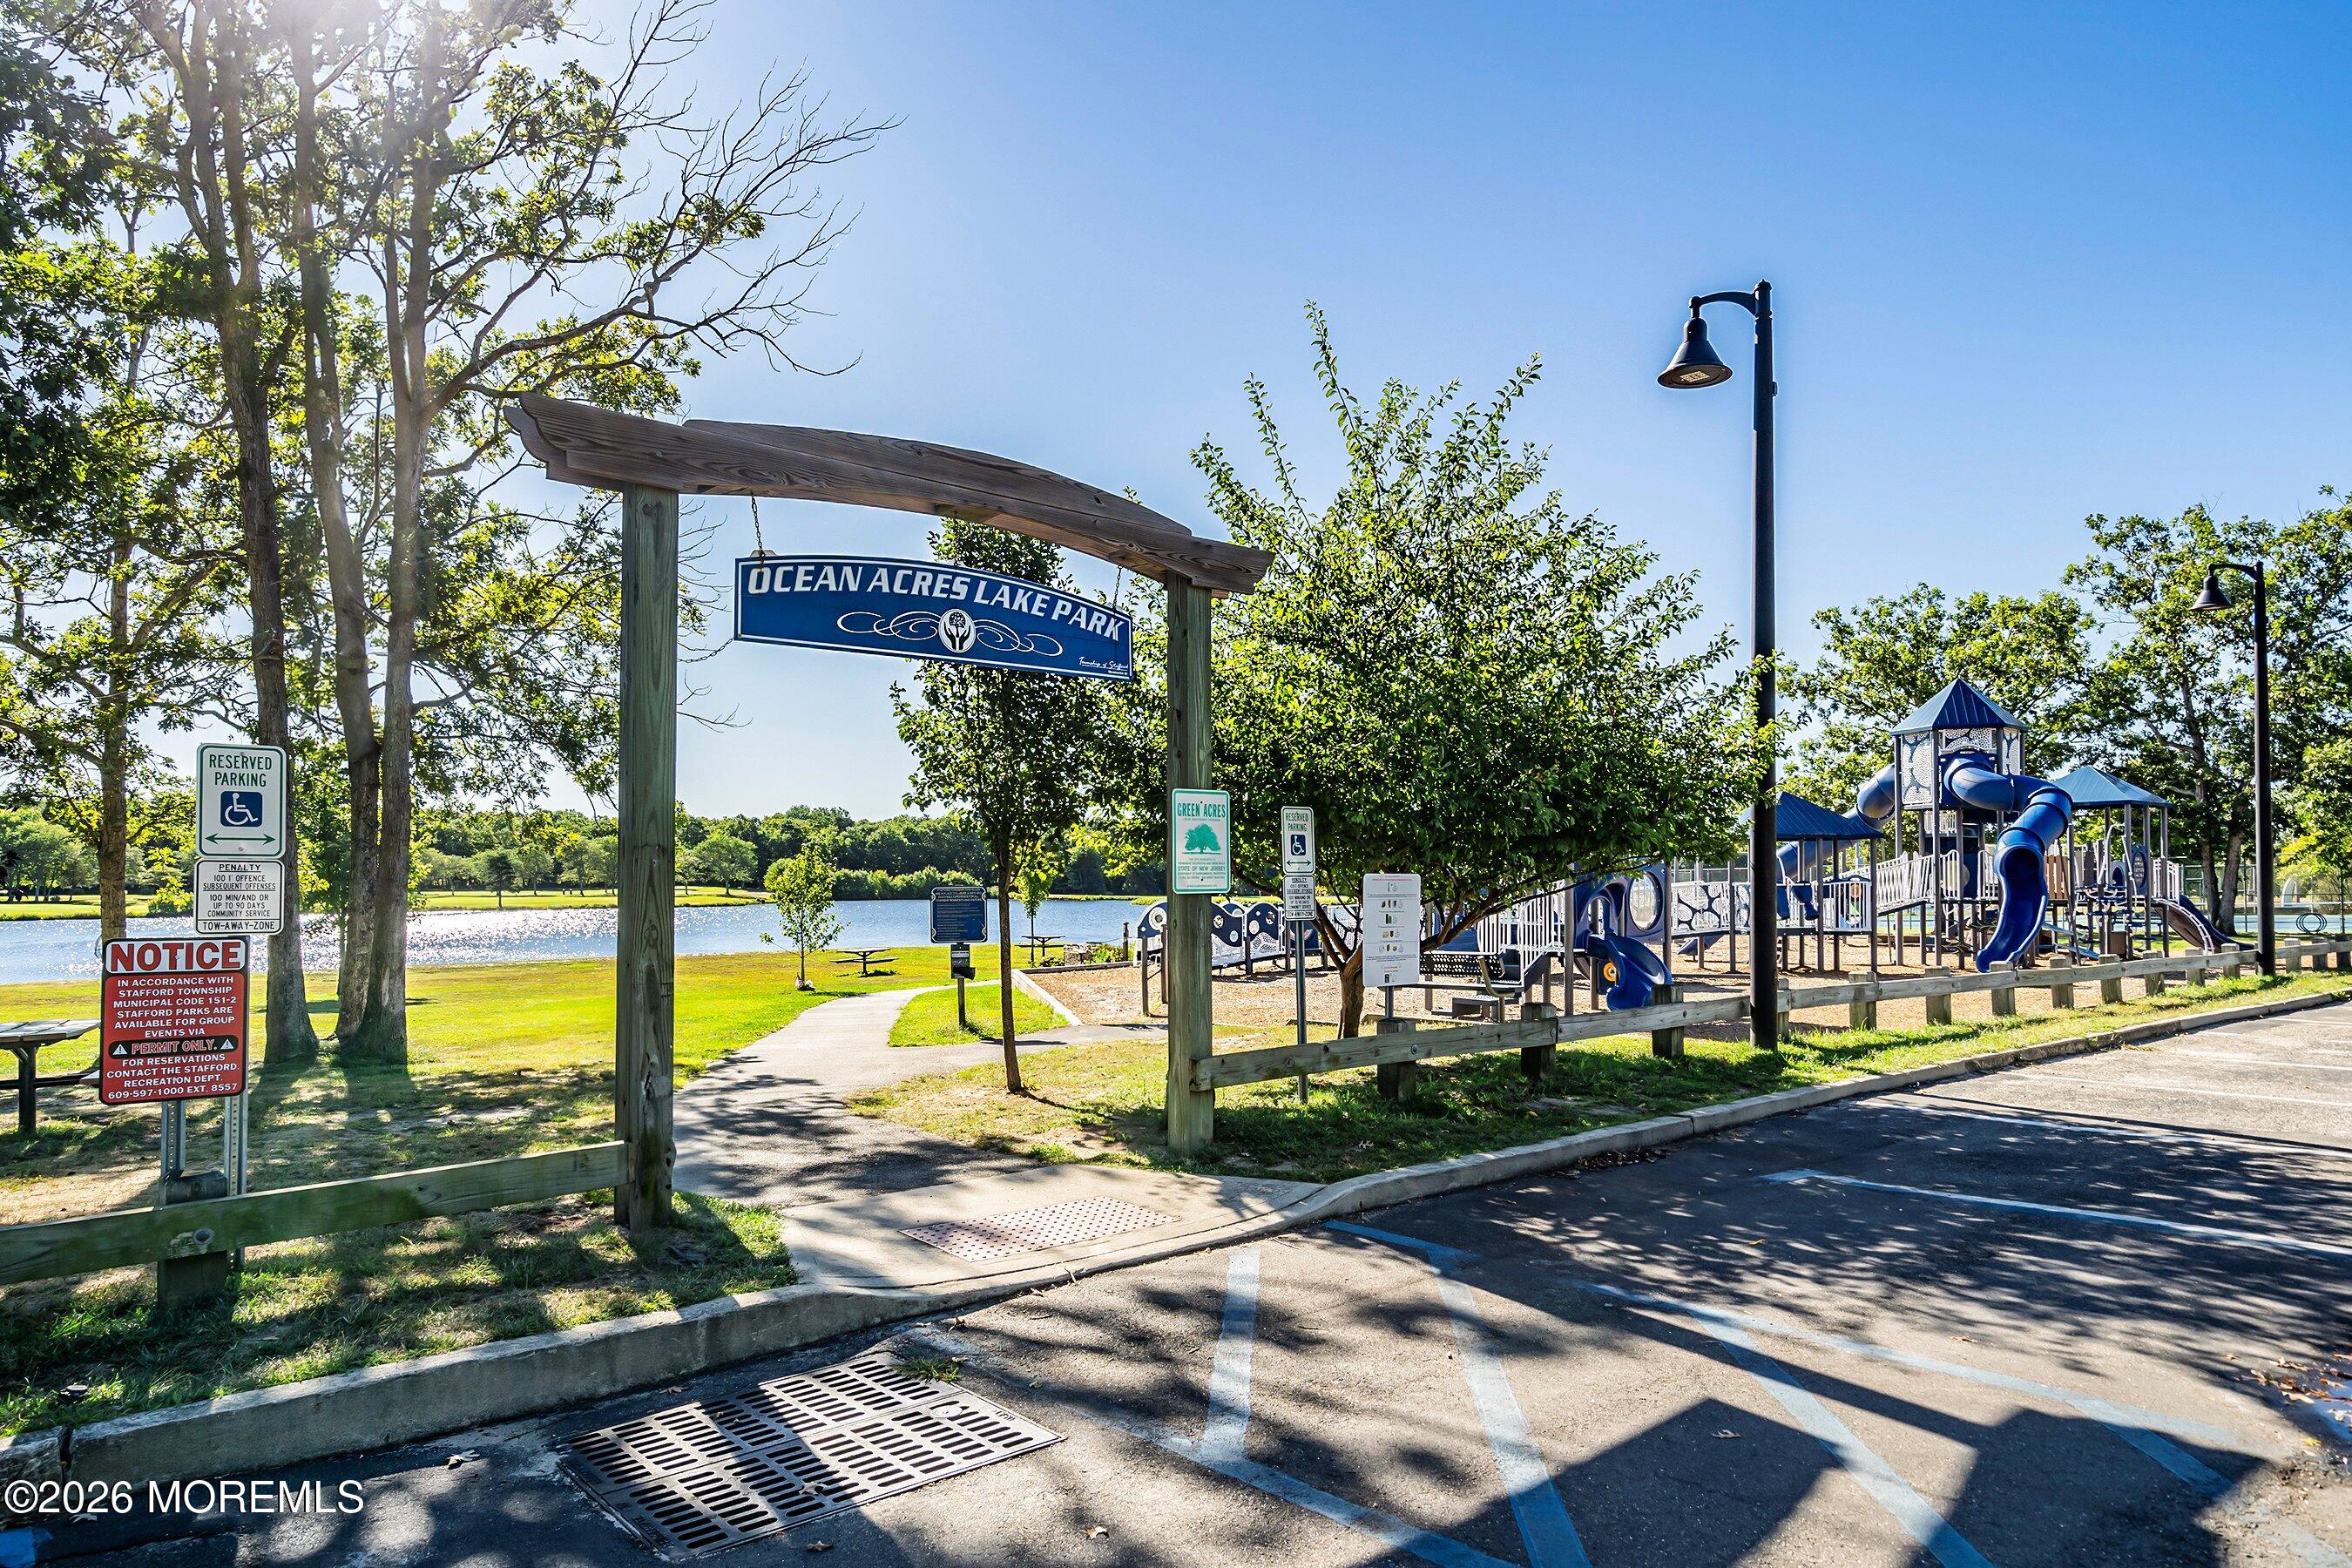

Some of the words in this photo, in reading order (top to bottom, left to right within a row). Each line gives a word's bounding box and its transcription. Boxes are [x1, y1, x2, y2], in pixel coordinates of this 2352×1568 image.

[748, 564, 863, 594] OCEAN
[867, 567, 971, 600] ACRES
[974, 580, 1051, 618] LAKE
[1051, 598, 1125, 642] PARK
[209, 754, 272, 770] RESERVED
[214, 772, 267, 787] PARKING
[1177, 802, 1200, 817] GREEN
[1203, 803, 1226, 818] ACRES
[1285, 812, 1309, 822] RESERVED
[1288, 822, 1308, 832] PARKING
[202, 921, 275, 930] TOW-AWAY-ZONE
[111, 942, 241, 972] NOTICE
[118, 979, 129, 988] IN
[132, 977, 205, 987] ACCORDANCE
[206, 976, 233, 984] WITH
[118, 988, 174, 997] STAFFORD
[177, 986, 233, 995] TOWNSHIP
[113, 998, 173, 1008] MUNICIPAL
[176, 997, 205, 1006] CODE
[208, 996, 237, 1004] 151-2
[117, 1009, 172, 1018] STAFFORD
[176, 1007, 210, 1016] PARKS
[114, 1018, 172, 1029] AVAILABLE
[175, 1017, 196, 1026] FOR
[199, 1016, 235, 1025] GROUP
[145, 1029, 186, 1038] EVENTS
[188, 1027, 206, 1036] VIA
[131, 1041, 179, 1055] PERMIT
[181, 1038, 218, 1052] ONLY.
[122, 1058, 144, 1067] FOR
[147, 1053, 226, 1065] RESERVATIONS
[106, 1068, 158, 1078] CONTACT
[161, 1066, 181, 1075] THE
[124, 1076, 192, 1088] RECREATION
[194, 1073, 223, 1083] DEPT.
[108, 1087, 184, 1099] 609-597-1000
[211, 1083, 238, 1092] 8557
